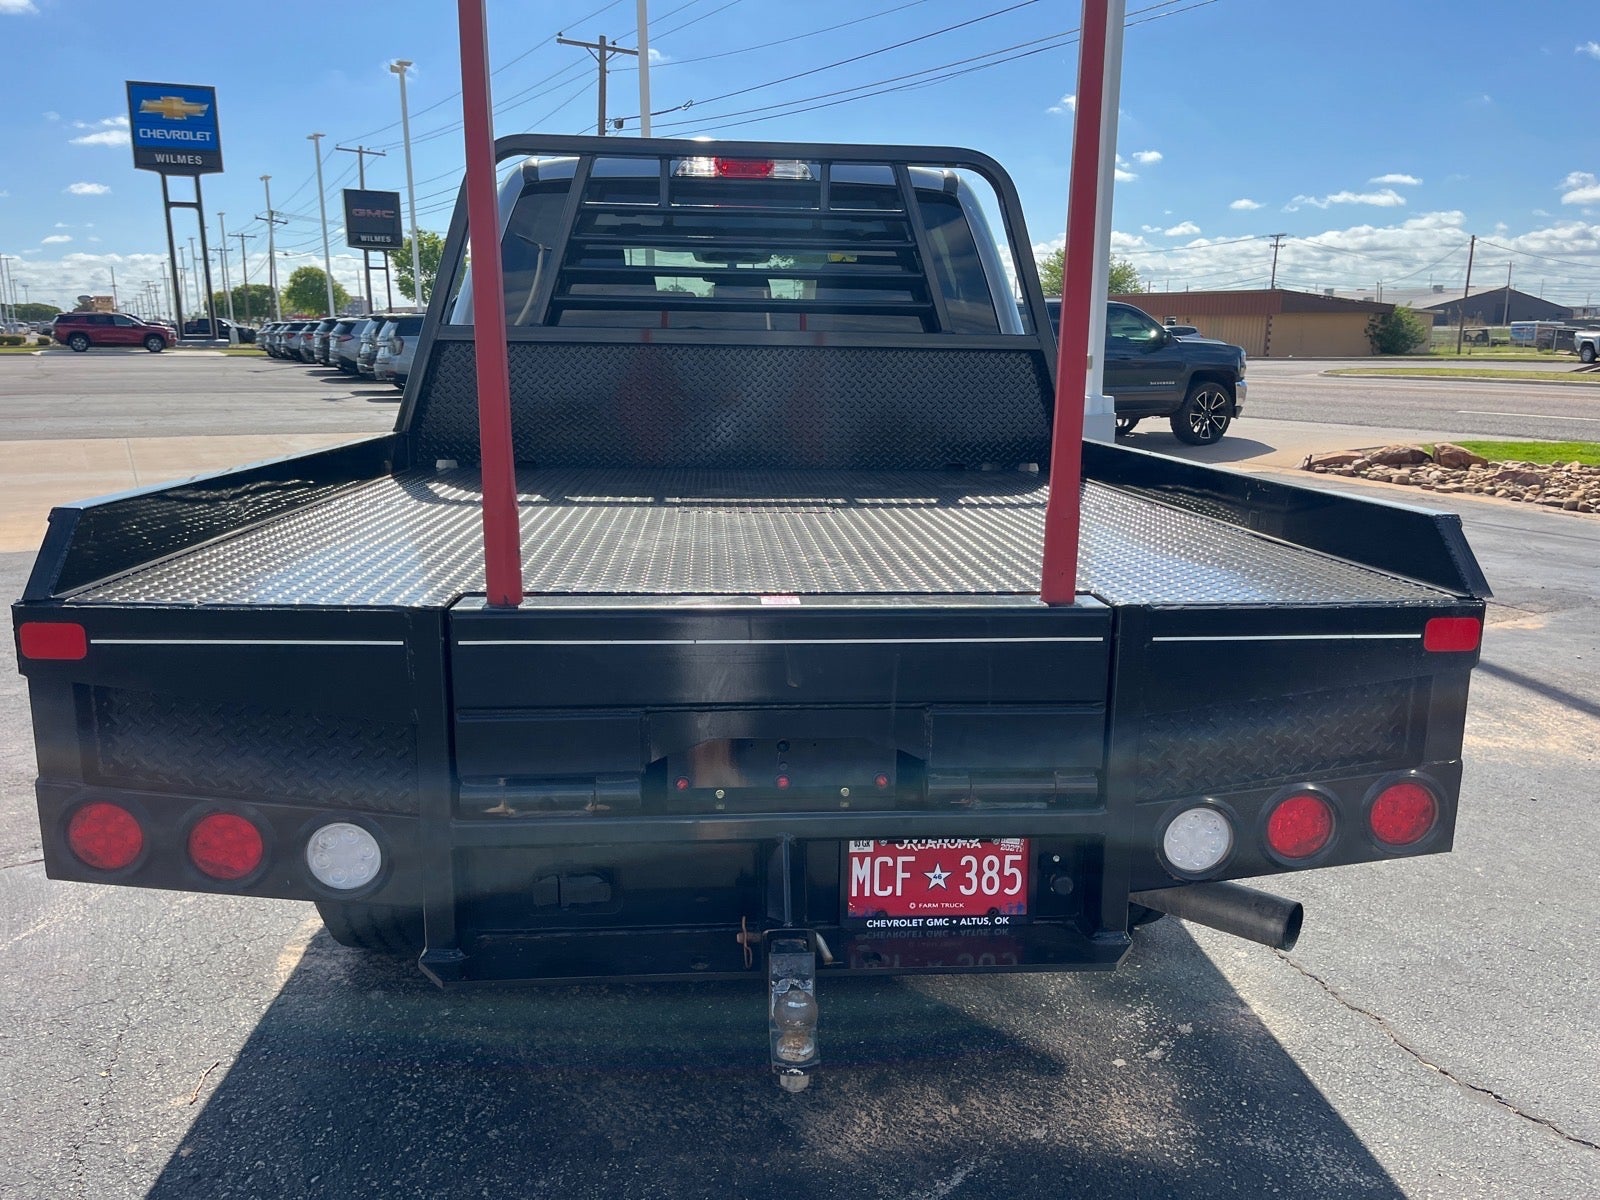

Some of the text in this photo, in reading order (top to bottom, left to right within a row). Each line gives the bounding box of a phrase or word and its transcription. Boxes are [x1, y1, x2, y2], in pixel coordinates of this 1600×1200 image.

[139, 128, 212, 141] CHEVROLET
[155, 153, 203, 165] WILMES
[352, 208, 395, 218] GMC
[360, 235, 392, 243] WILMES
[852, 855, 1023, 897] MCF 385
[866, 916, 1010, 928] CHEVROLET GMC ALTUS, OK
